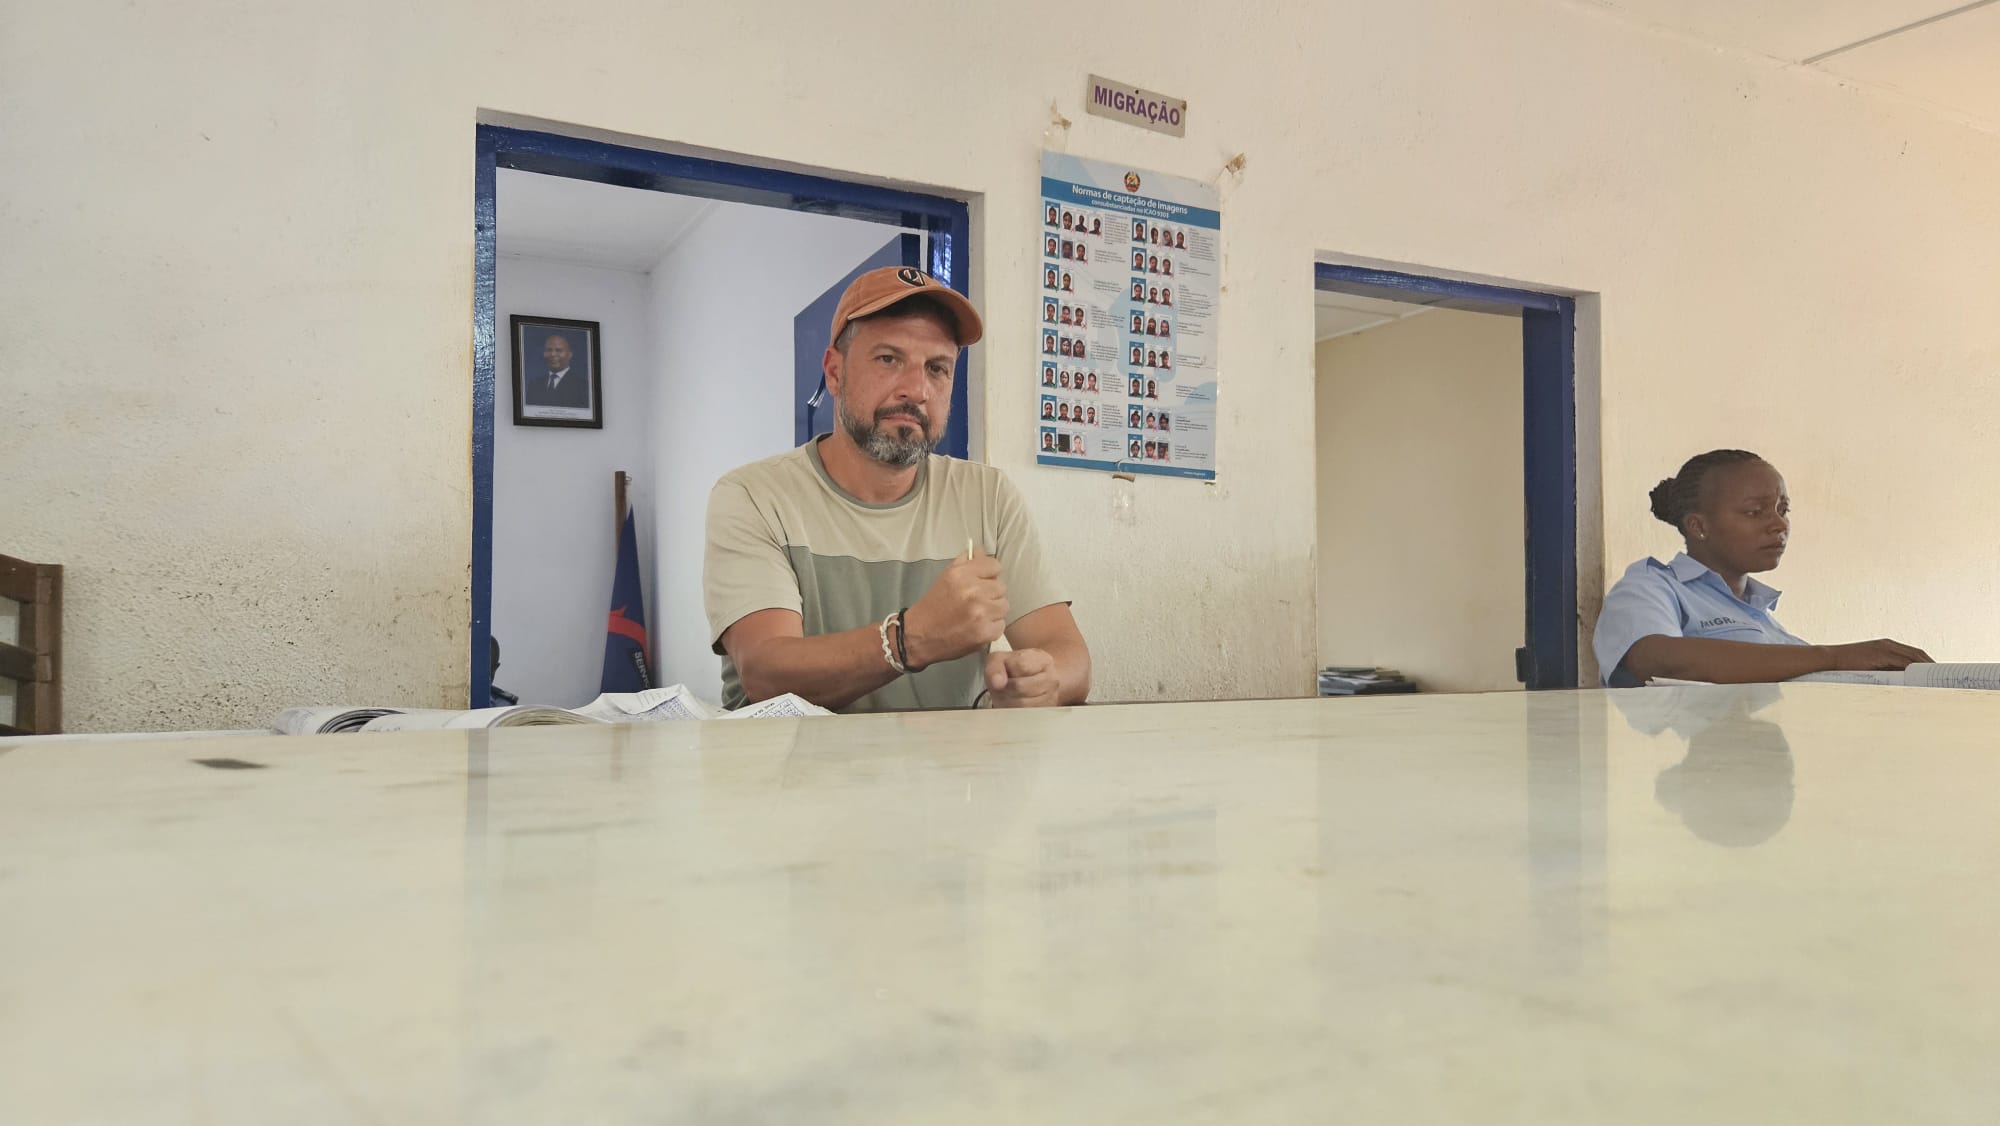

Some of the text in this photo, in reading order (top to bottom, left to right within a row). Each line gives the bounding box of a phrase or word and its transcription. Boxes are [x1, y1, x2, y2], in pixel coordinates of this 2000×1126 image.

[1094, 85, 1180, 126] MIGRAÇÃO
[1072, 184, 1101, 198] Normas
[1102, 190, 1112, 200] de
[1113, 193, 1146, 206] captação
[1147, 199, 1157, 209] de
